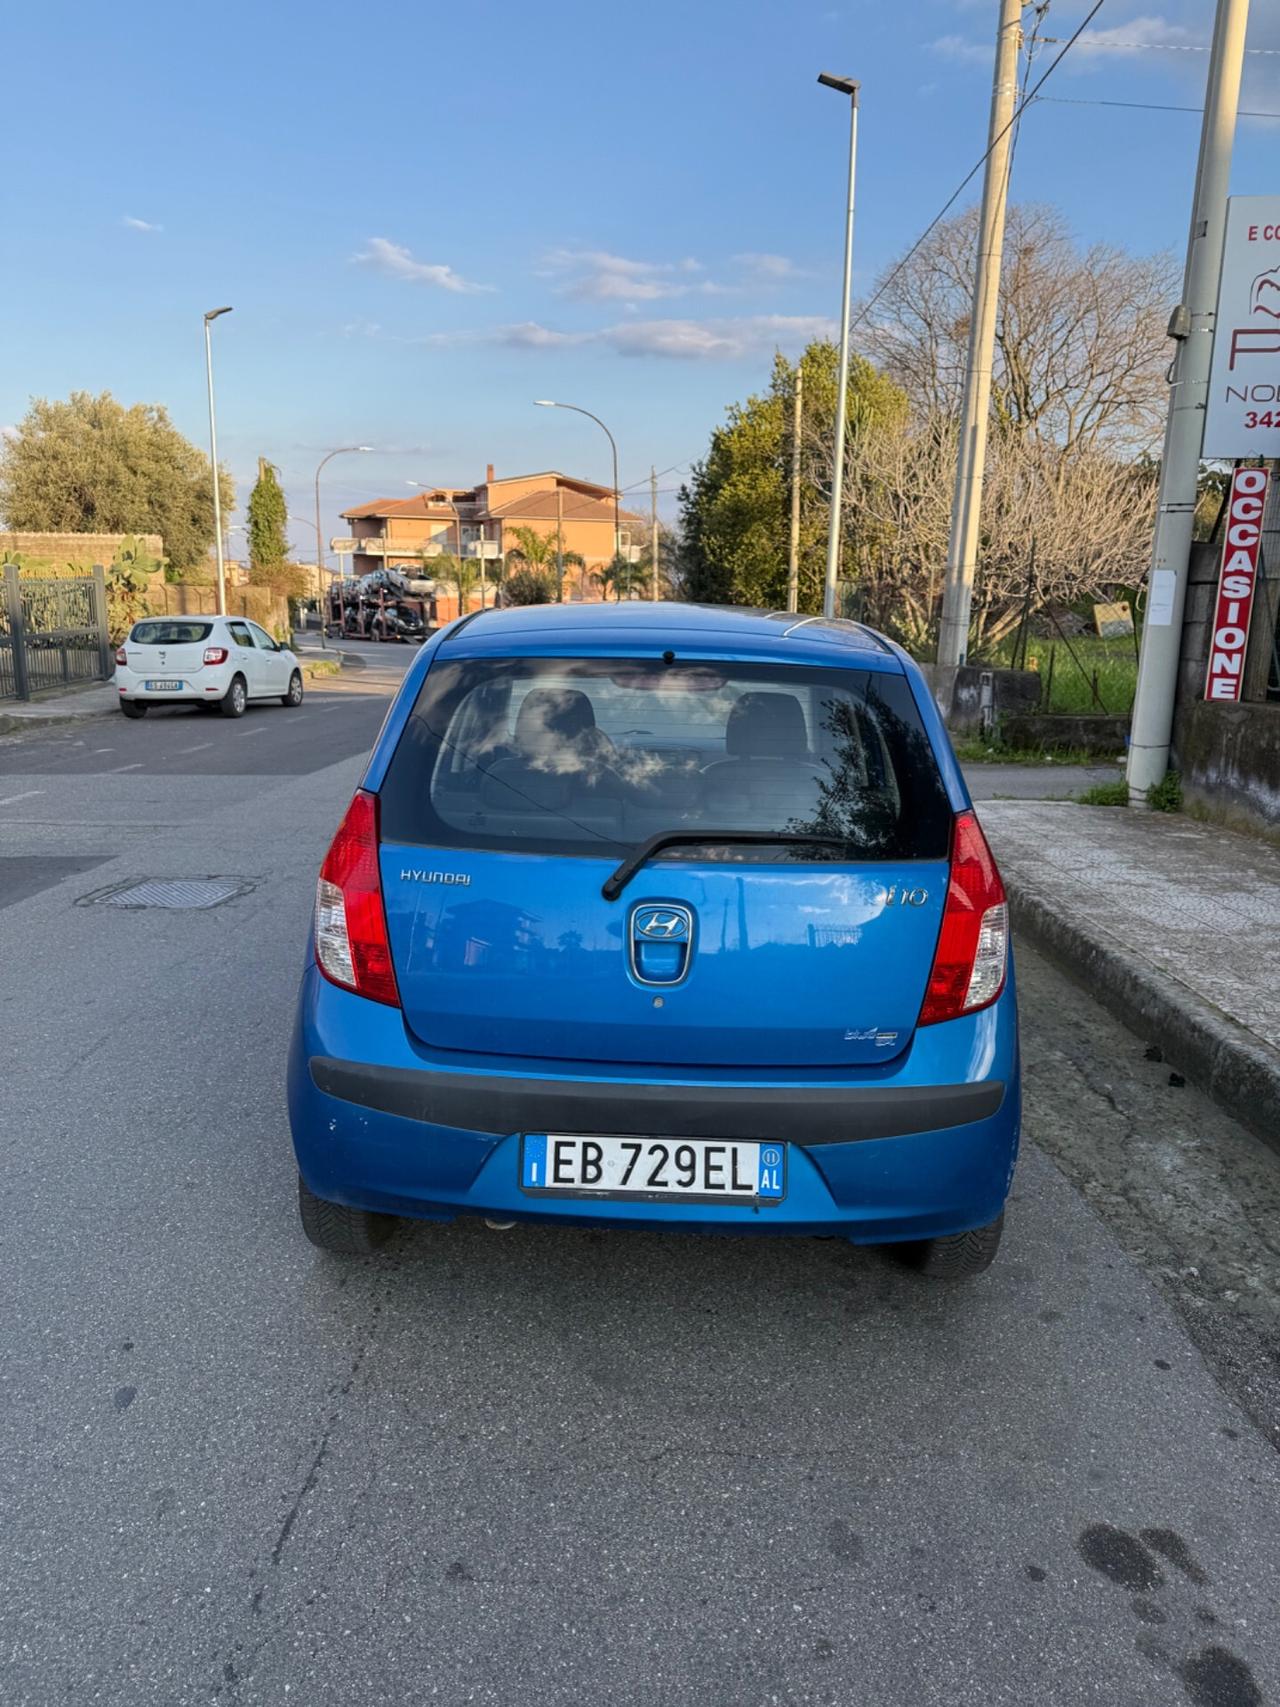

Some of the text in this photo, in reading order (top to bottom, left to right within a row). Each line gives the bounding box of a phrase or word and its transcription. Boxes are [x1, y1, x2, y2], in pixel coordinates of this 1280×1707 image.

[1248, 225, 1258, 241] E
[1211, 470, 1267, 699] OCCASIONE
[400, 868, 471, 886] HYUNDAI
[886, 885, 928, 906] i10
[552, 1141, 604, 1185] EB
[619, 1143, 754, 1191] 729EL
[760, 1169, 780, 1190] AL
